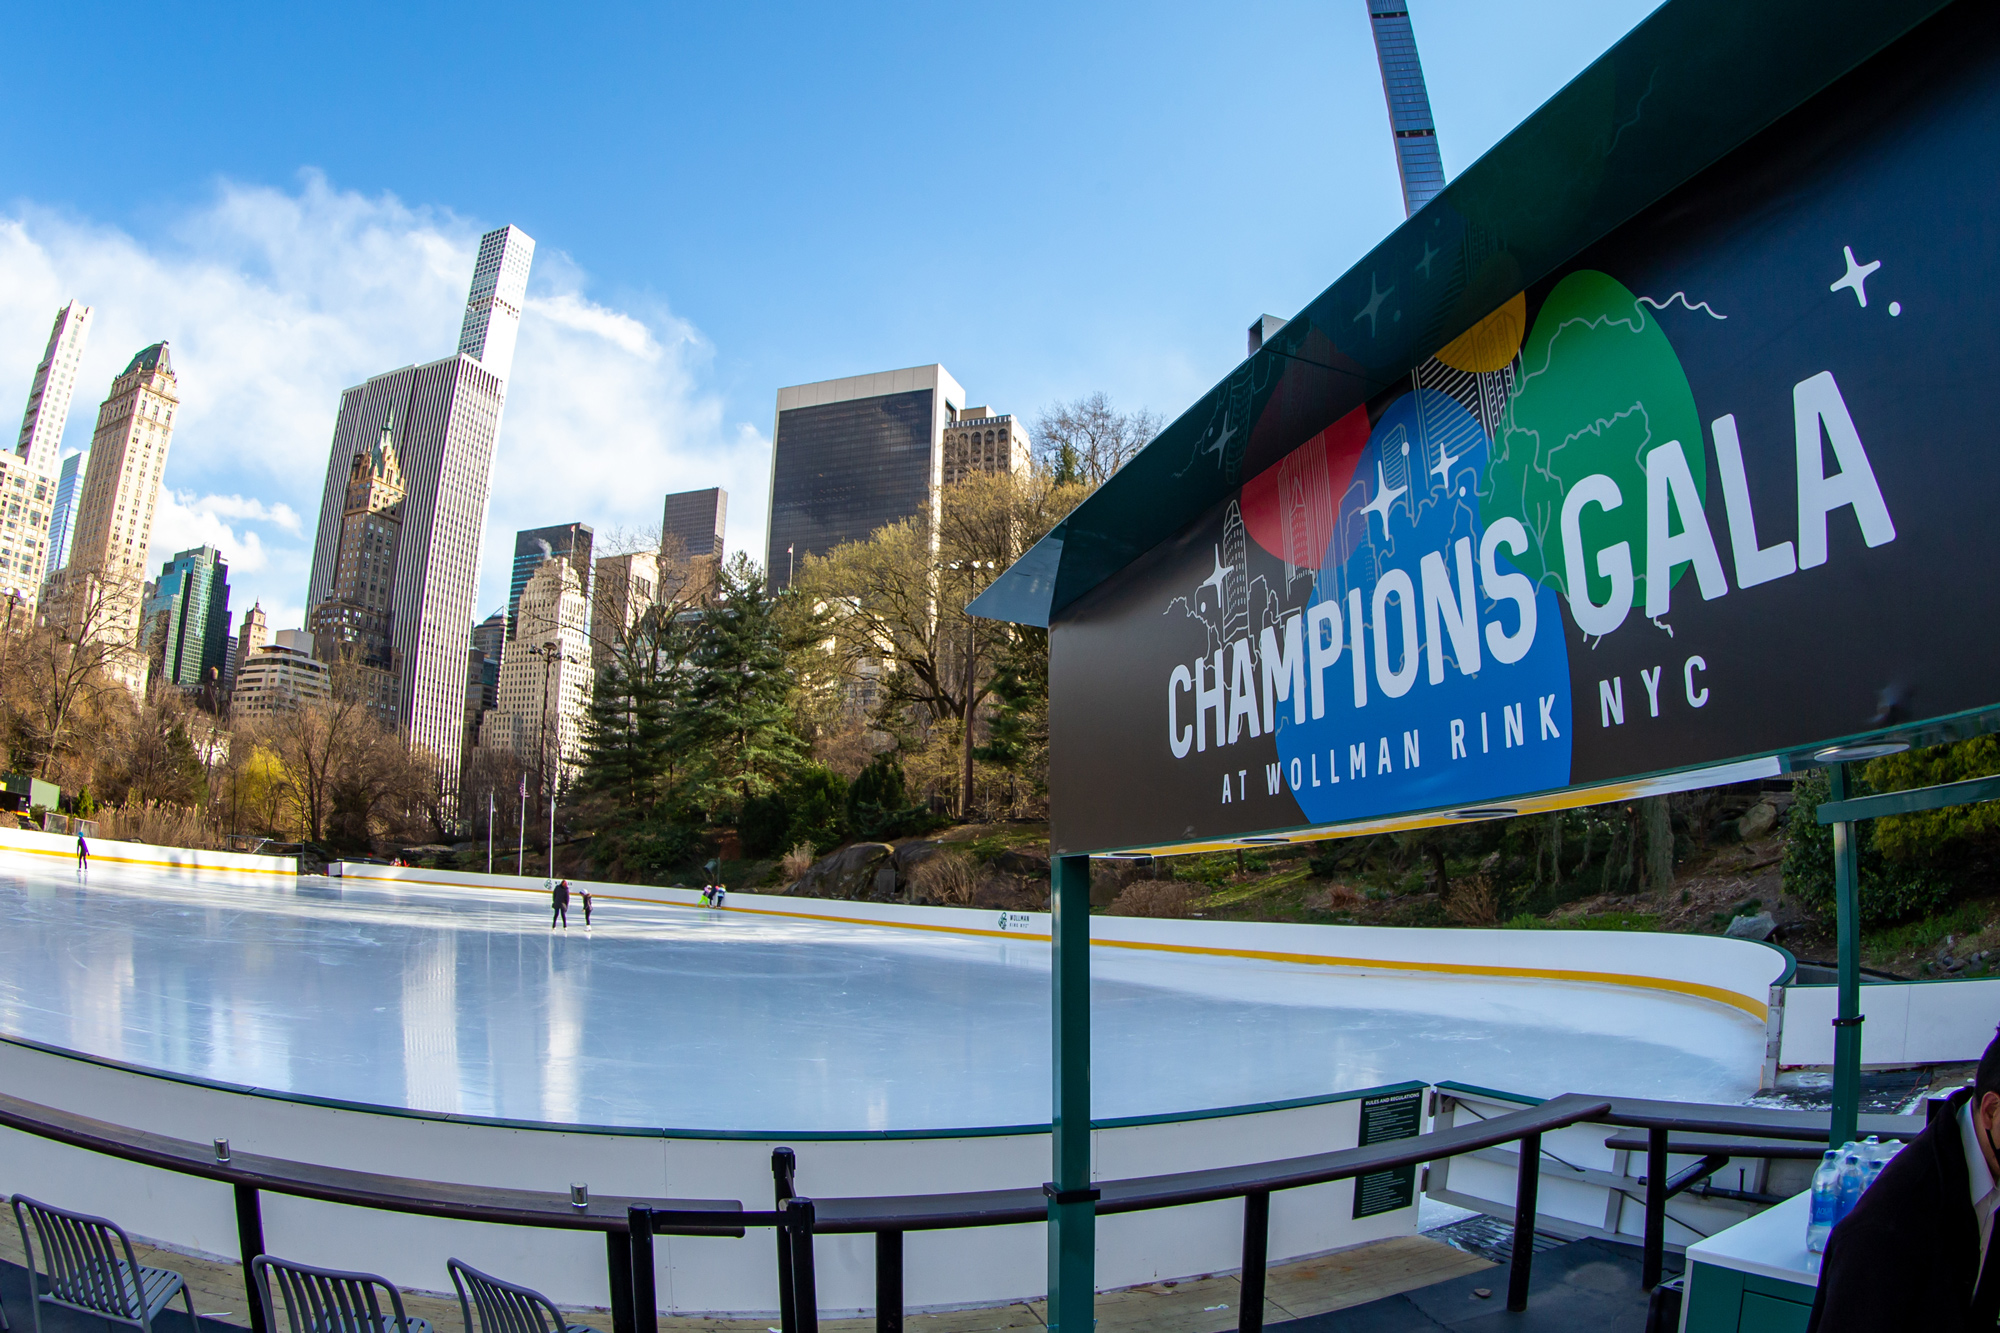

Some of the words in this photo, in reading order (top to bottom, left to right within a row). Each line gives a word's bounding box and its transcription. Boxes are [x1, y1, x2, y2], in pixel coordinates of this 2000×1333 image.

[1168, 516, 1538, 759] CHAMPIONS
[1561, 370, 1897, 637] GALA
[1222, 768, 1248, 803] AT
[1266, 729, 1421, 795] WOLLMAN
[1450, 693, 1561, 760] RINK
[1599, 655, 1709, 728] NYC
